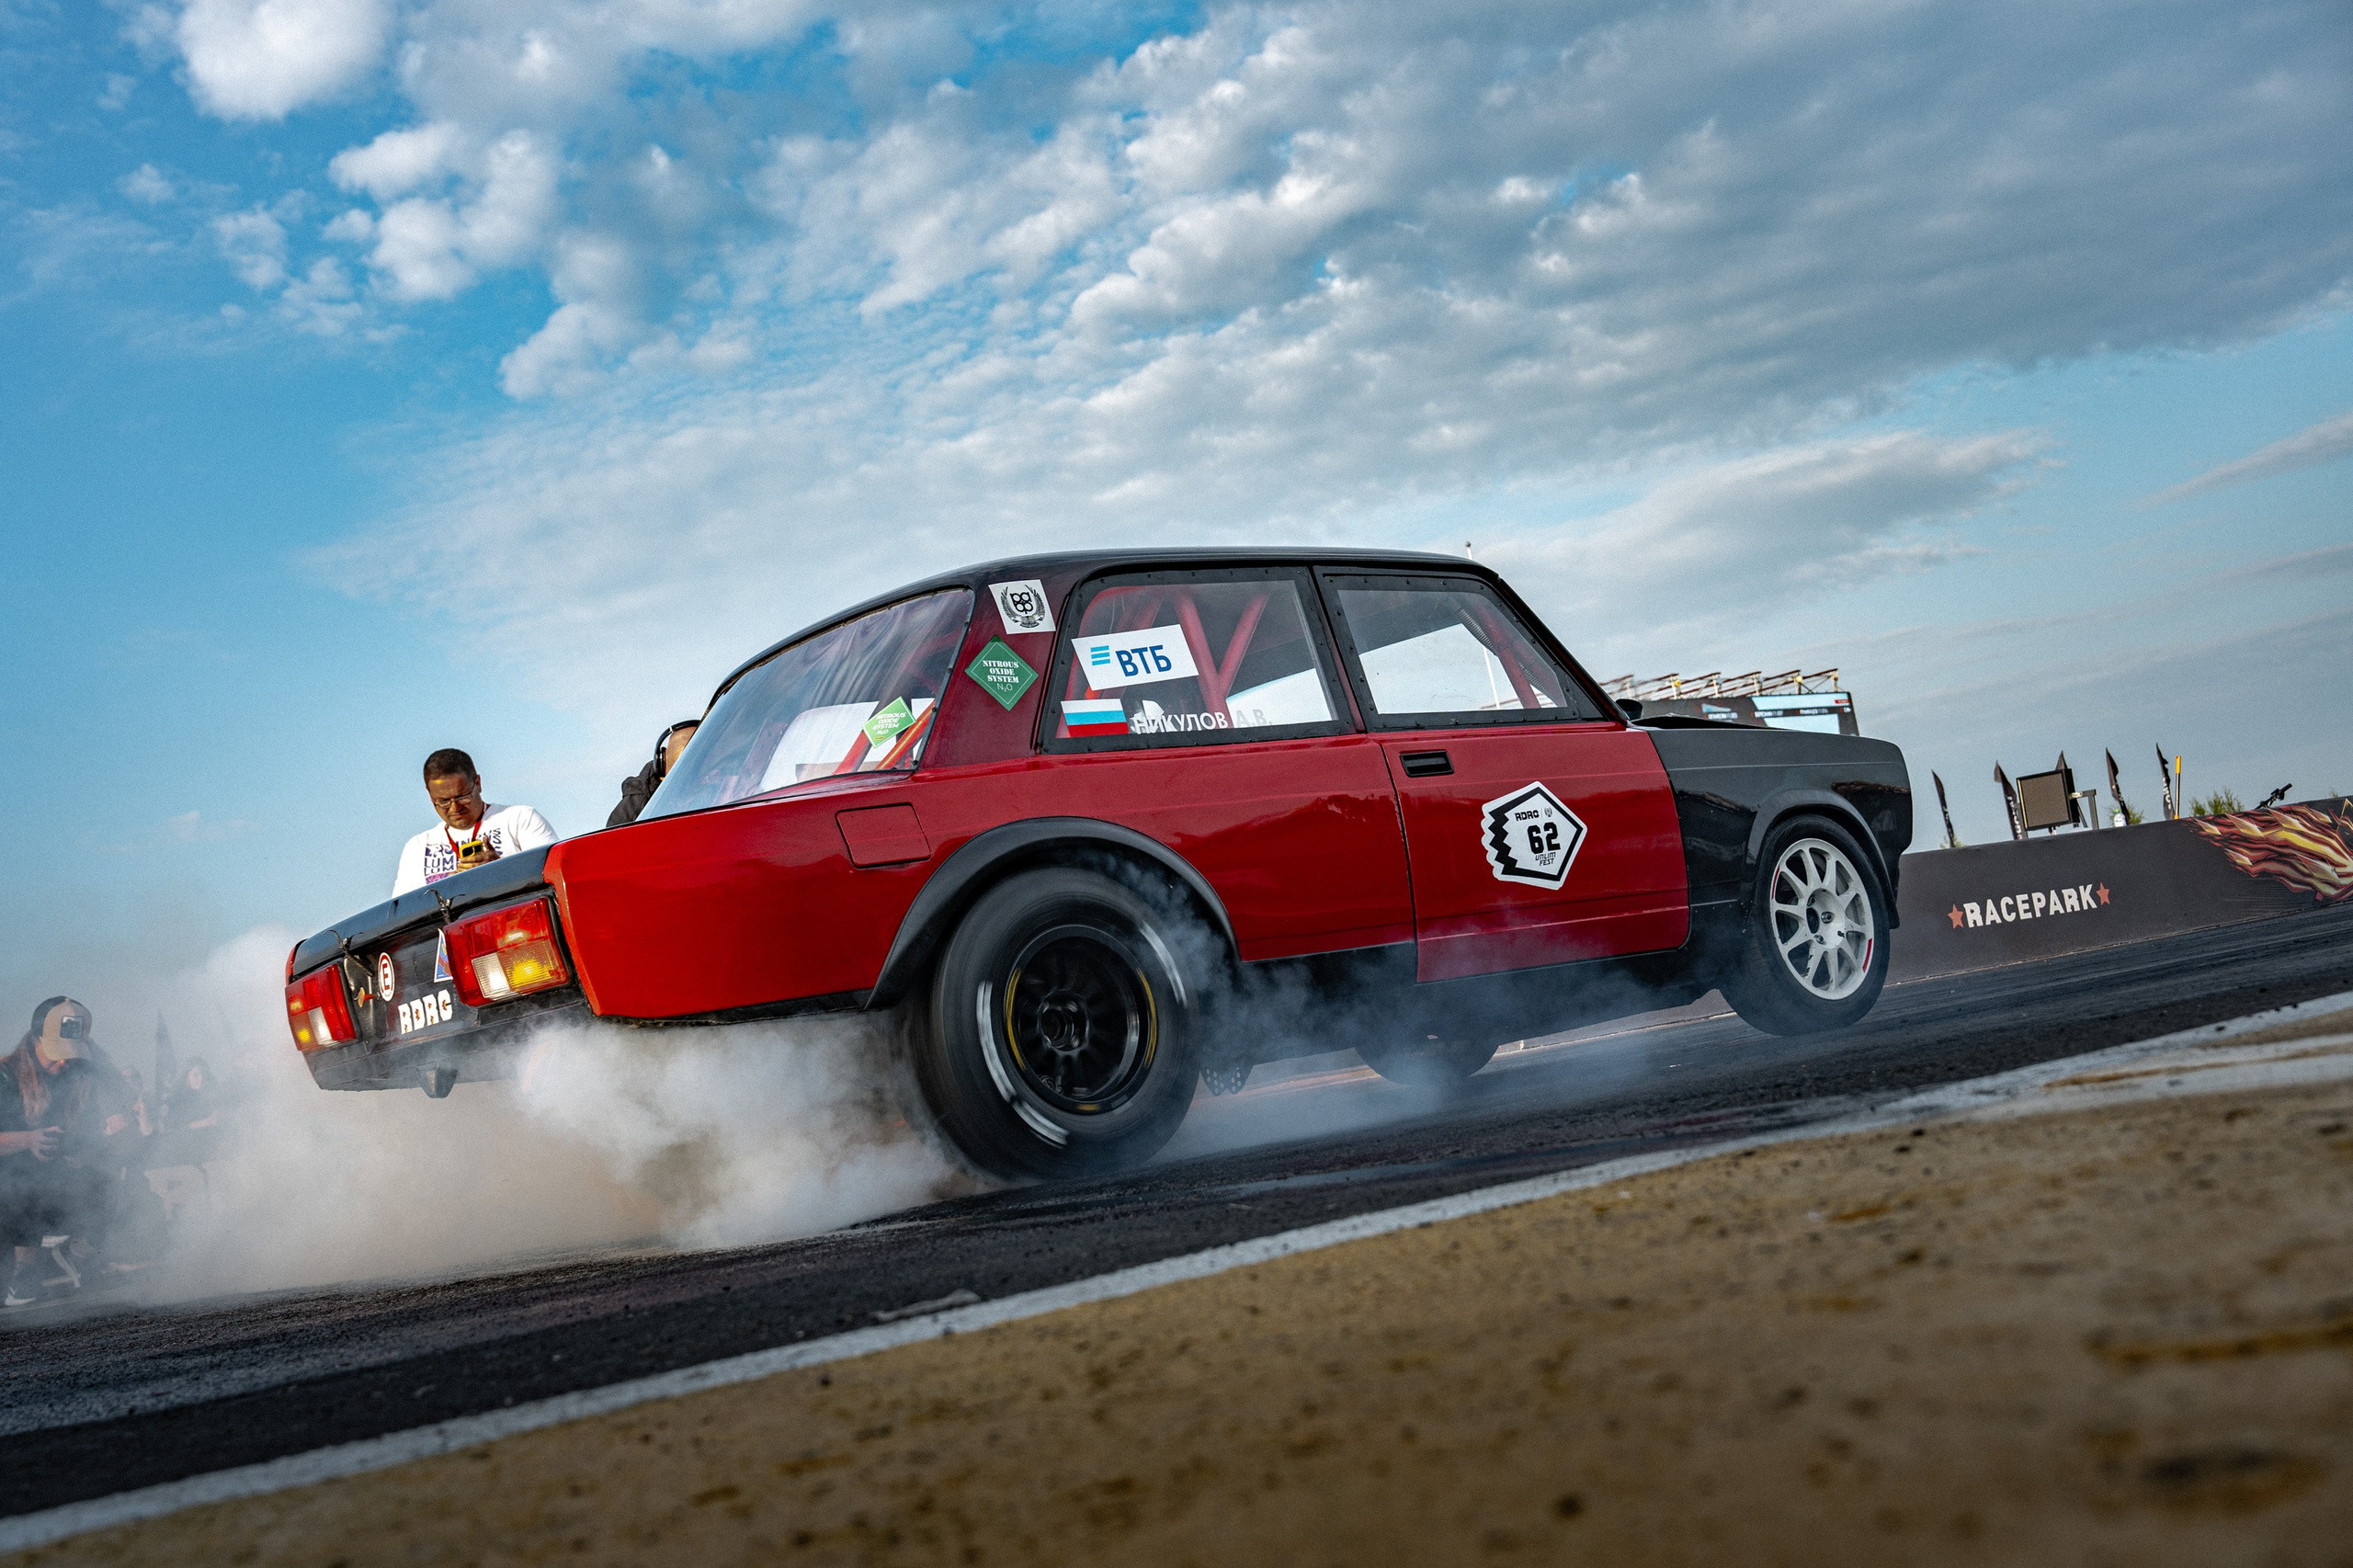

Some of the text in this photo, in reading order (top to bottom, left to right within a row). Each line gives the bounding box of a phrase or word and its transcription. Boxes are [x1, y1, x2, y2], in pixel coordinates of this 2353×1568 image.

[983, 660, 1019, 668] NITROUS
[1115, 644, 1172, 676] ВТБ
[987, 675, 1019, 683] SYSTEM
[989, 667, 1015, 676] OXIDE
[1515, 810, 1540, 822] RDRC
[1527, 822, 1561, 855] 62
[1963, 884, 2097, 928] RACEPARK
[398, 989, 452, 1034] RDRC
